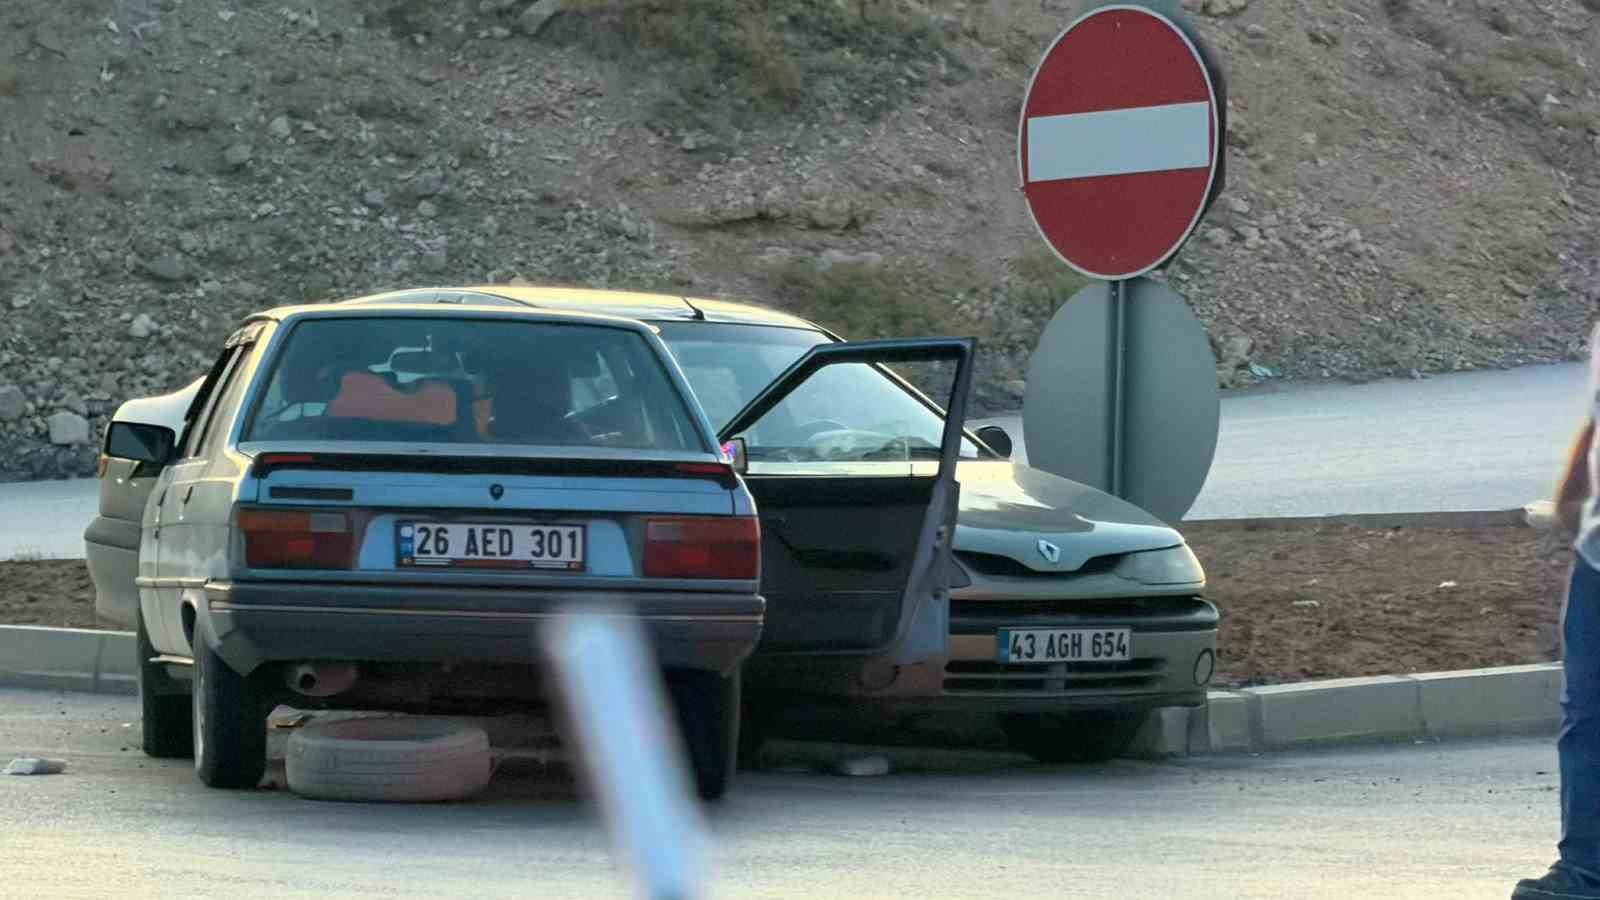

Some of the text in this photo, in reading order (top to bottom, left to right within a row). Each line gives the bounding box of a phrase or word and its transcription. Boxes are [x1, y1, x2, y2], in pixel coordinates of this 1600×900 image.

[416, 527, 449, 556] 26
[465, 528, 513, 557] AED
[531, 530, 577, 558] 301
[1011, 632, 1126, 659] 43 AGH 654
